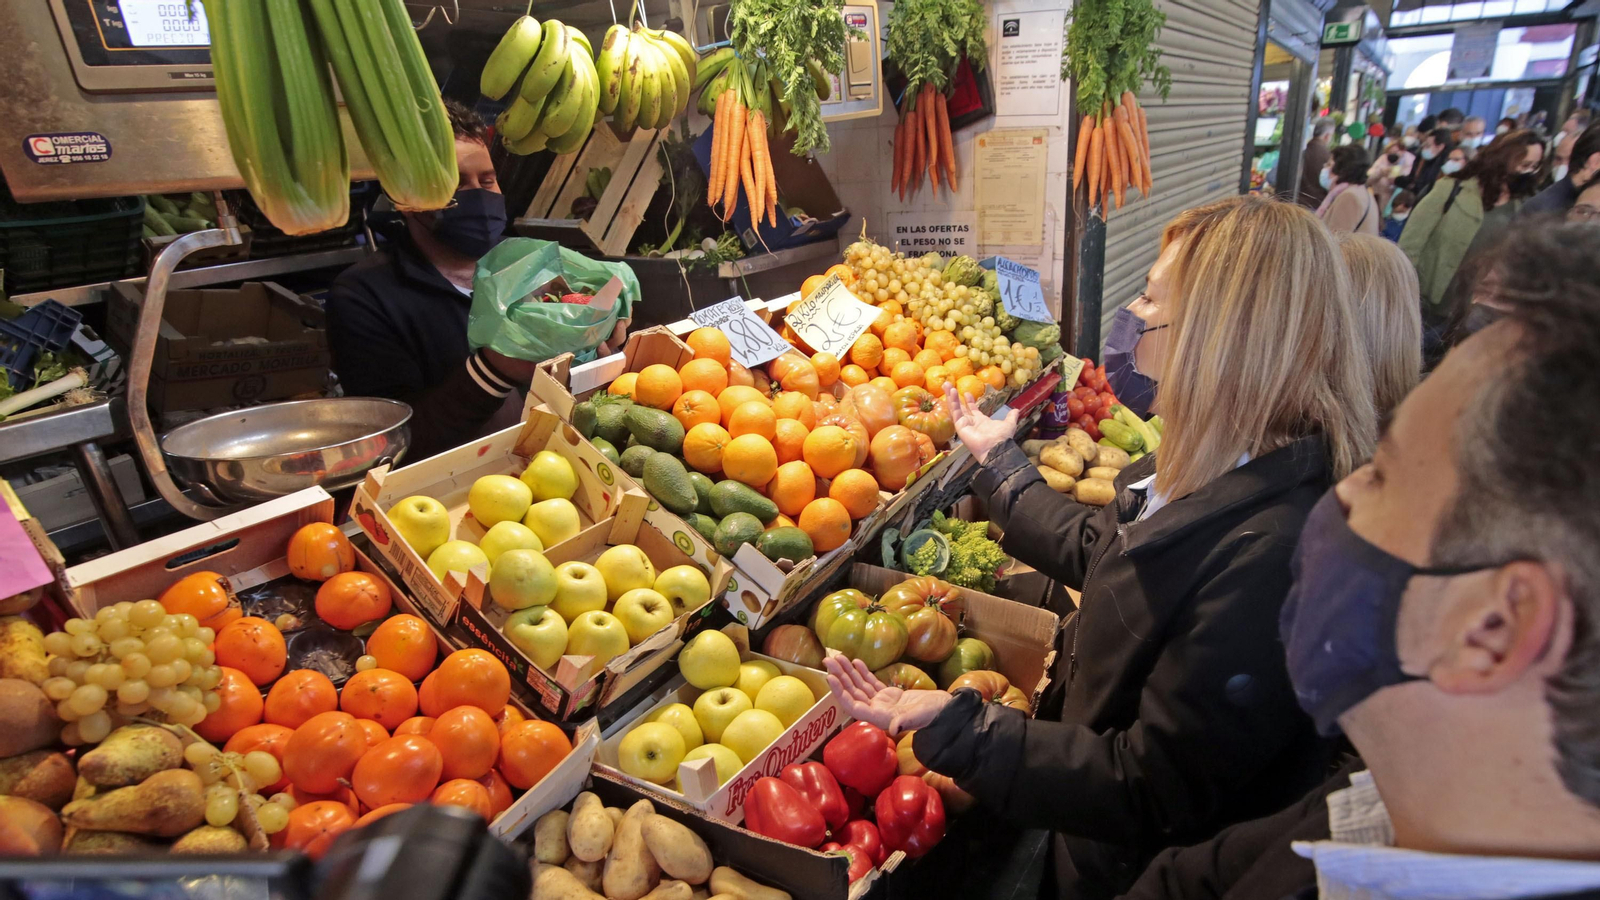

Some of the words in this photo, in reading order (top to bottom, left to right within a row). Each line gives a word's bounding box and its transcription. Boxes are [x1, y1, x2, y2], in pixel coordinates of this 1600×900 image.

[106, 5, 119, 14] kg
[111, 20, 123, 29] kg
[896, 226, 908, 234] EN
[929, 225, 969, 233] OFERTAS
[914, 238, 936, 246] PESO
[938, 238, 951, 246] NO
[954, 238, 965, 246] SE
[177, 361, 252, 378] MERCADO
[260, 355, 321, 372] MONTILLA
